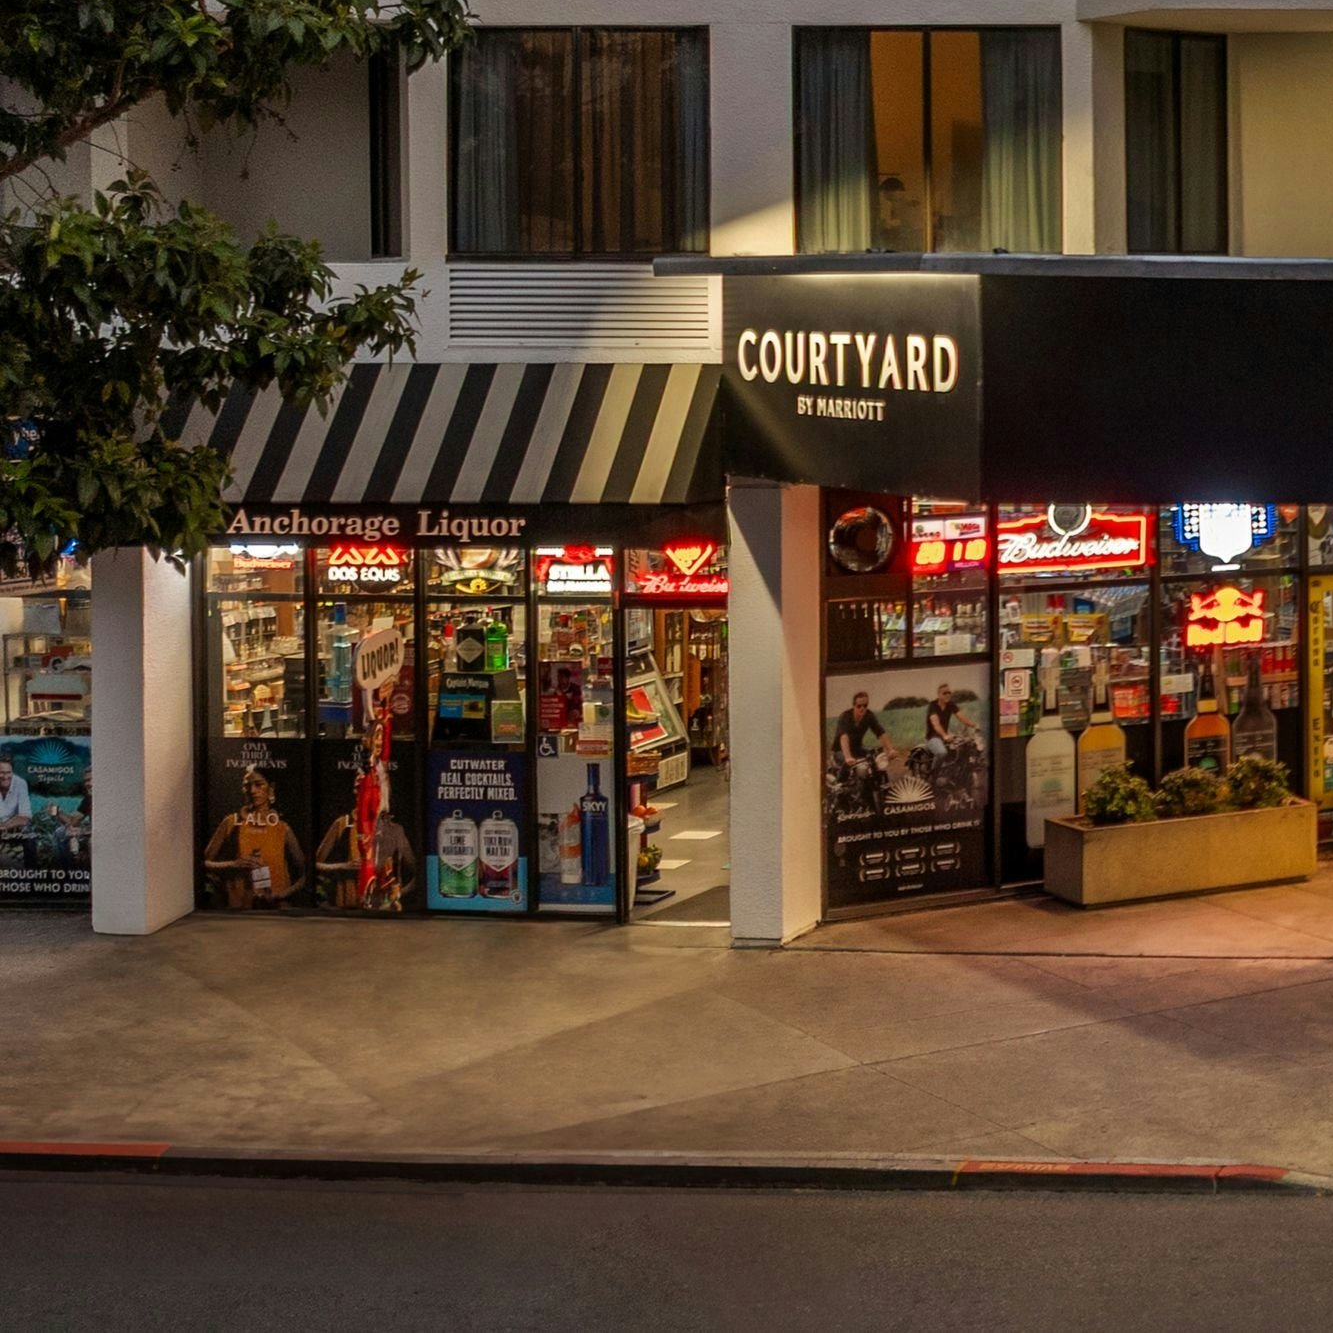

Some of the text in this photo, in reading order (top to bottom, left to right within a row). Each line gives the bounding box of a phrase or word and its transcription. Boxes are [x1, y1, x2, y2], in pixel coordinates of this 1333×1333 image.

[738, 329, 959, 393] COURTYARD
[797, 395, 886, 421] BY MARRIOTT
[226, 509, 527, 542] Anchorage Liquor
[998, 533, 1140, 563] Budweiser
[233, 558, 292, 569] Budweiser
[328, 567, 401, 582] DOS EQUIS
[549, 564, 611, 581] STELLA
[361, 637, 399, 681] LIQUOR!
[27, 766, 75, 775] CASAMIGOS
[450, 759, 506, 770] CUTWATER
[440, 772, 515, 787] REAL COCKTAILS.
[437, 786, 485, 800] PERFECTLY
[582, 800, 607, 813] SKYY
[883, 802, 937, 816] CASAMIGOS
[234, 813, 280, 826] LALO
[837, 832, 872, 843] BROUGHT
[873, 831, 883, 839] TO
[884, 829, 899, 837] YOU
[900, 828, 909, 836] BY
[910, 825, 933, 834] THOSE
[933, 823, 951, 831] WHO
[952, 820, 973, 829] DRINK
[50, 869, 66, 880] TO
[33, 882, 61, 893] WHO
